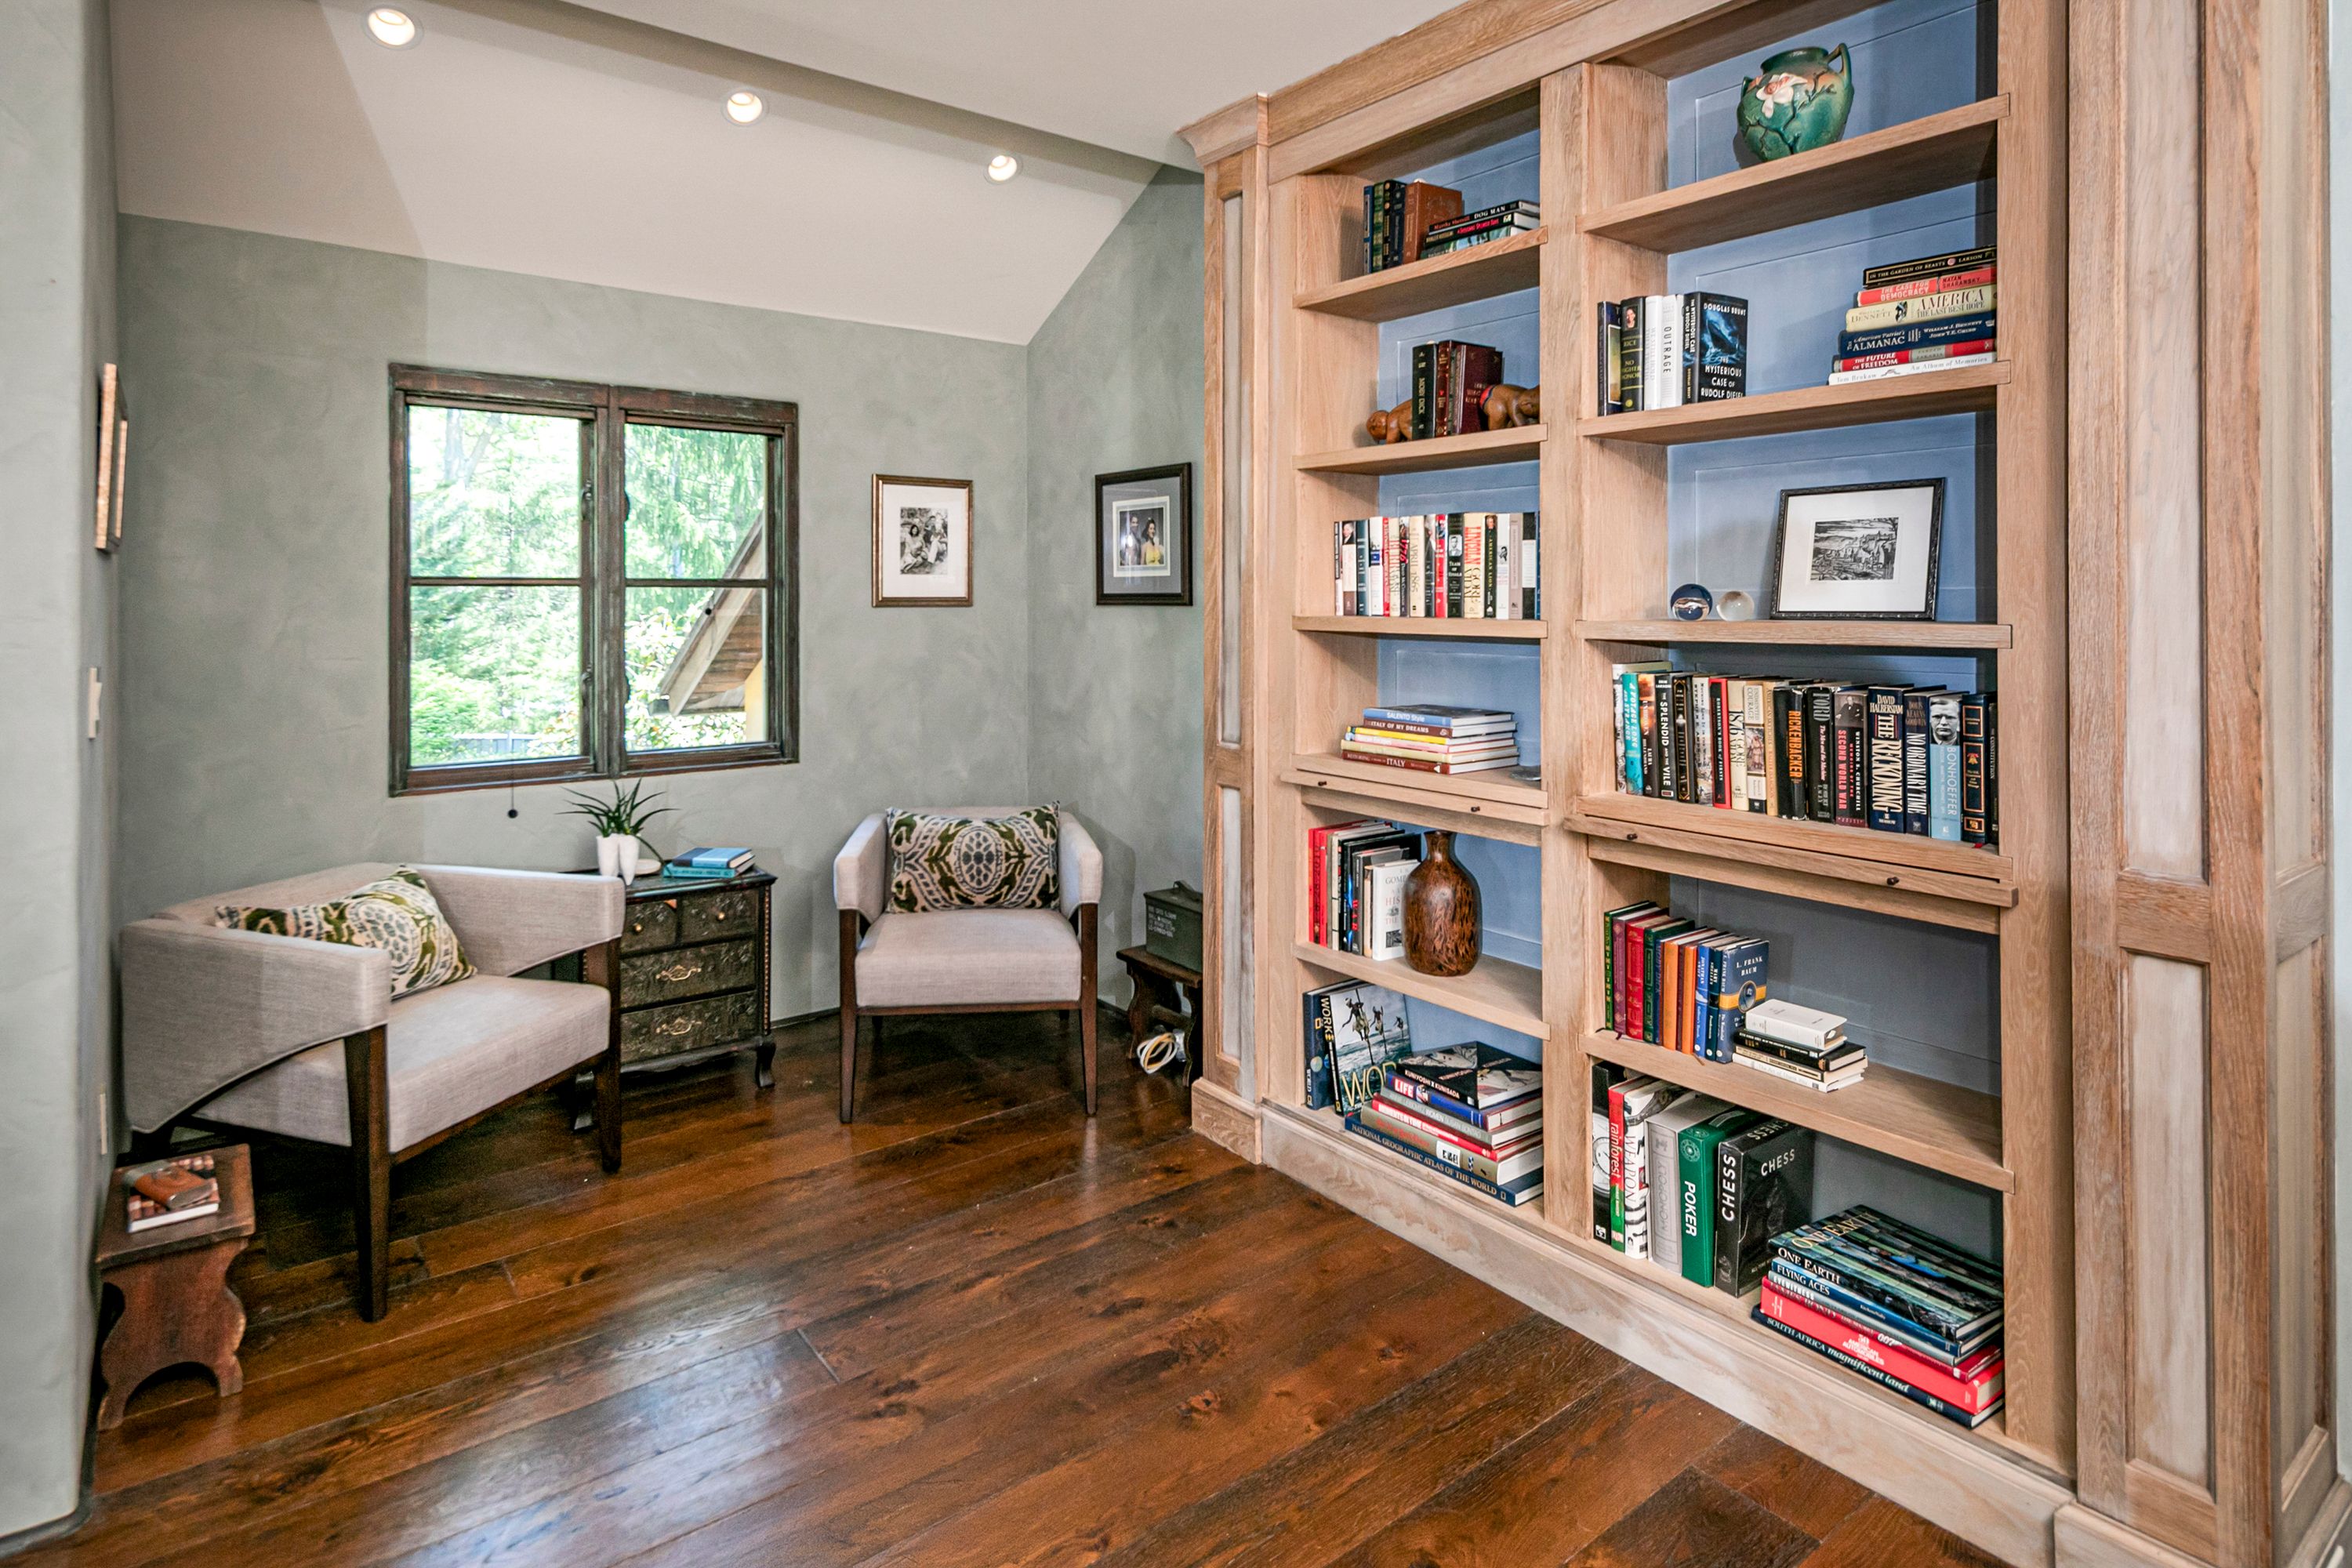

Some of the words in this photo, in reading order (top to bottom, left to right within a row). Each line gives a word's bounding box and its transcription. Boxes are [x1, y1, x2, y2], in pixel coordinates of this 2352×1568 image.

[1474, 211, 1488, 220] DOG
[1890, 266, 1914, 275] GARDEN
[1924, 260, 1946, 270] BEASTS
[1958, 254, 1983, 263] LARSON
[1942, 275, 1962, 284] NATAN
[1943, 277, 1981, 289] SHARANSKY
[1880, 287, 1929, 302] DEMOCRACY
[1919, 289, 1984, 310] AMERICA
[1703, 303, 1730, 314] DOUGLAS
[1731, 307, 1747, 317] BRUNT
[1851, 312, 1891, 323] BENNETT
[1917, 309, 1929, 318] THE
[1930, 307, 1946, 317] LAST
[1947, 304, 1964, 314] BEST
[1965, 301, 1985, 310] HOPE
[1923, 325, 1949, 334] WILLIAM
[1955, 320, 1983, 329] BENNETT
[1853, 336, 1905, 351] ALMANAC
[1854, 333, 1882, 343] American
[1663, 326, 1671, 374] OUTRAGE
[1866, 353, 1896, 362] FUTURE
[1704, 365, 1742, 377] MYSTERIOUS
[1860, 359, 1899, 370] FREEDOM
[1922, 361, 1944, 370] Album
[1954, 357, 1988, 366] Memories
[1711, 376, 1727, 387] CASE
[1851, 373, 1877, 382] Brokaw
[1700, 387, 1725, 398] RUDOLF
[1726, 390, 1744, 398] DIESEL
[1399, 539, 1408, 564] 1776
[1410, 542, 1419, 566] APRIL
[1465, 527, 1481, 564] LINCOLN
[1410, 572, 1419, 593] 1865
[1813, 692, 1830, 721] FORD
[1870, 702, 1904, 715] HALBERSTAM
[1877, 695, 1896, 706] DAVID
[1386, 712, 1410, 721] SALENTO
[1411, 713, 1425, 723] Style
[1660, 701, 1670, 746] SPLENDID
[1730, 710, 1745, 735] 1876
[1877, 715, 1895, 739] THE
[1406, 724, 1428, 734] DREAMS
[1906, 732, 1926, 745] NO
[1788, 710, 1803, 779] RICKENBACKER
[1838, 729, 1847, 760] SECOND
[1386, 757, 1406, 768] ITALY
[1907, 746, 1927, 793] ORDINARY
[1662, 767, 1671, 786] VILE
[1838, 764, 1847, 790] WORLD
[1871, 739, 1903, 813] RECKONING
[1947, 746, 1958, 815] BONHOEFFER
[1838, 792, 1847, 810] WAR
[1907, 793, 1927, 815] TIME
[1744, 955, 1763, 966] FRANK
[1740, 966, 1758, 977] BAUM
[1320, 996, 1332, 1032] WORK
[1394, 1078, 1414, 1098] LIFE
[1405, 1069, 1431, 1085] KUNIYOSHI
[1435, 1082, 1460, 1098] KUNISADA
[1748, 1120, 1789, 1140] CHESS
[1352, 1124, 1381, 1142] NATIONAL
[1382, 1134, 1423, 1162] GEOGRAPHIC
[1424, 1155, 1446, 1171] ATLAS
[1446, 1164, 1457, 1176] OF
[1455, 1170, 1470, 1183] THE
[1470, 1177, 1497, 1195] WORLD
[1610, 1123, 1623, 1178] rainforest
[1624, 1135, 1635, 1204] WEAPON
[1761, 1148, 1795, 1176] CHESS
[1657, 1160, 1668, 1232] MONOPOLY
[1722, 1154, 1737, 1221] CHESS
[1684, 1181, 1697, 1237] POKER
[1791, 1225, 1834, 1250] ONE
[1829, 1212, 1881, 1236] EARTH
[1778, 1247, 1802, 1265] ONE
[1803, 1258, 1841, 1285] EARTH
[1773, 1275, 1815, 1301] EYEWITNESS
[1777, 1264, 1807, 1286] FLYING
[1808, 1279, 1830, 1297] ACES
[1877, 1333, 1895, 1347] 007
[1766, 1317, 1796, 1338] SOUTH
[1796, 1330, 1827, 1352] AFRICA
[1828, 1346, 1884, 1378] magnificent
[1885, 1374, 1910, 1394] land
